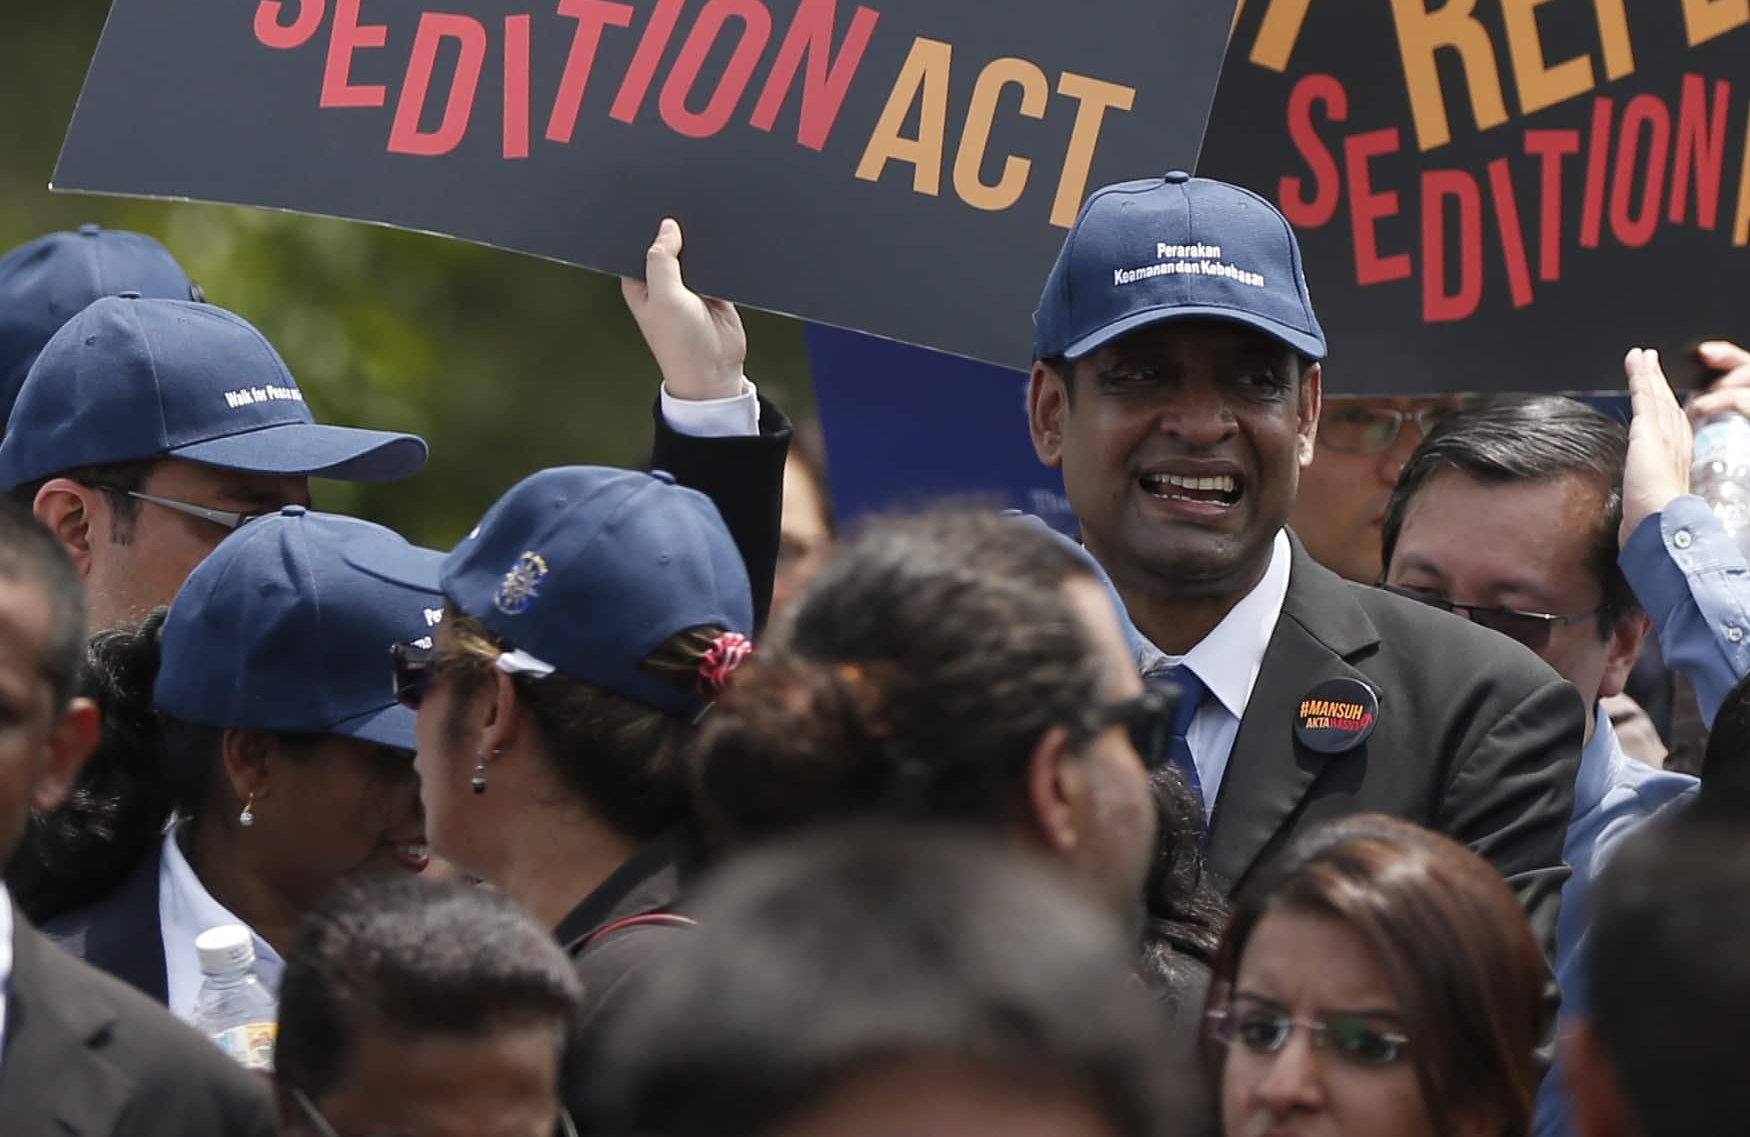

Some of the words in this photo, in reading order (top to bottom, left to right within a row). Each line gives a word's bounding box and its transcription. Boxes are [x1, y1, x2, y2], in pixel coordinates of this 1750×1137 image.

[856, 37, 1135, 228] ACT
[1277, 72, 1731, 324] SEDITION
[1156, 241, 1221, 258] Perarakan
[1113, 263, 1175, 286] Keamanan
[1176, 260, 1199, 274] dan
[1200, 259, 1265, 287] Kebebasan
[224, 388, 254, 408] Walk
[1299, 700, 1364, 720] #MANSUH
[1305, 717, 1330, 729] AKTA
